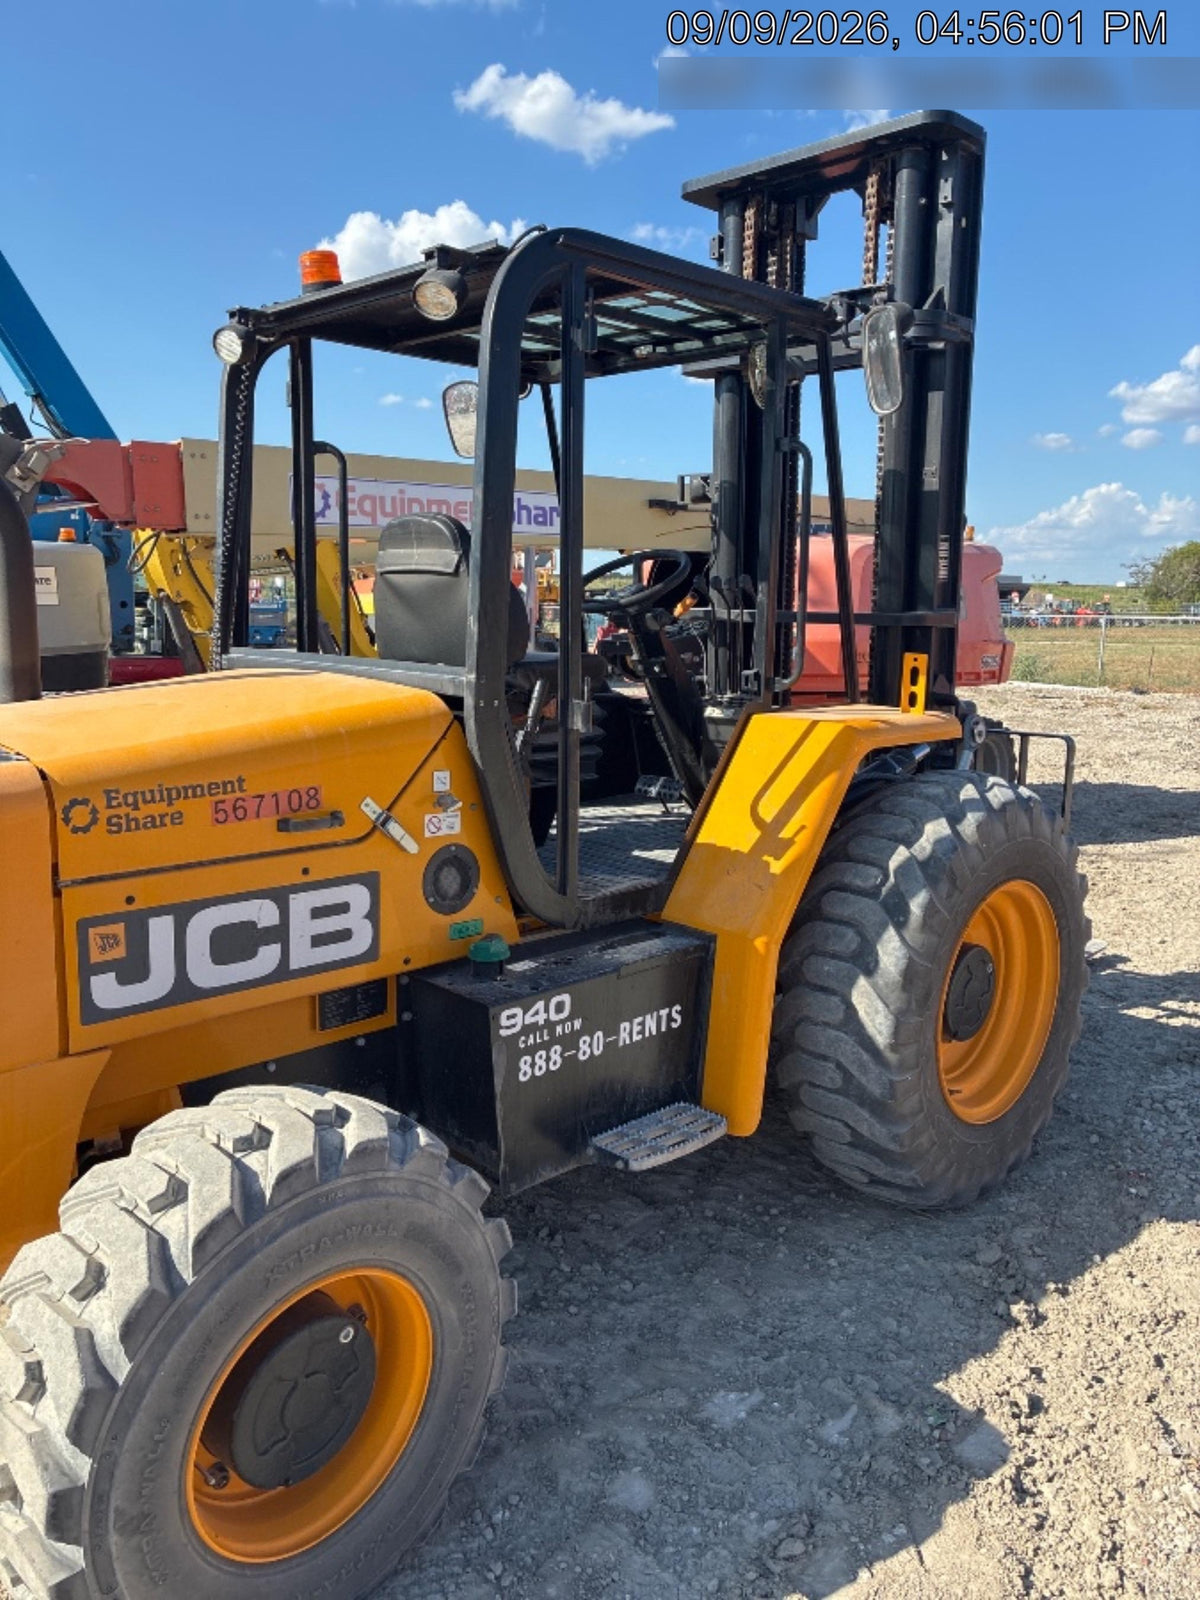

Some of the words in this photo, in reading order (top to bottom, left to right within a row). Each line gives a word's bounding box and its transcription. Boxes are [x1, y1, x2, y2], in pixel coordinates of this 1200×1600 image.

[103, 775, 247, 811] Equipment
[213, 786, 321, 824] 567108
[106, 809, 184, 835] Share
[90, 883, 374, 1009] JCB
[499, 993, 571, 1037] 940
[518, 1029, 550, 1048] CALL
[555, 1017, 583, 1037] NOW
[518, 1003, 682, 1082] 888-80-RENTS
